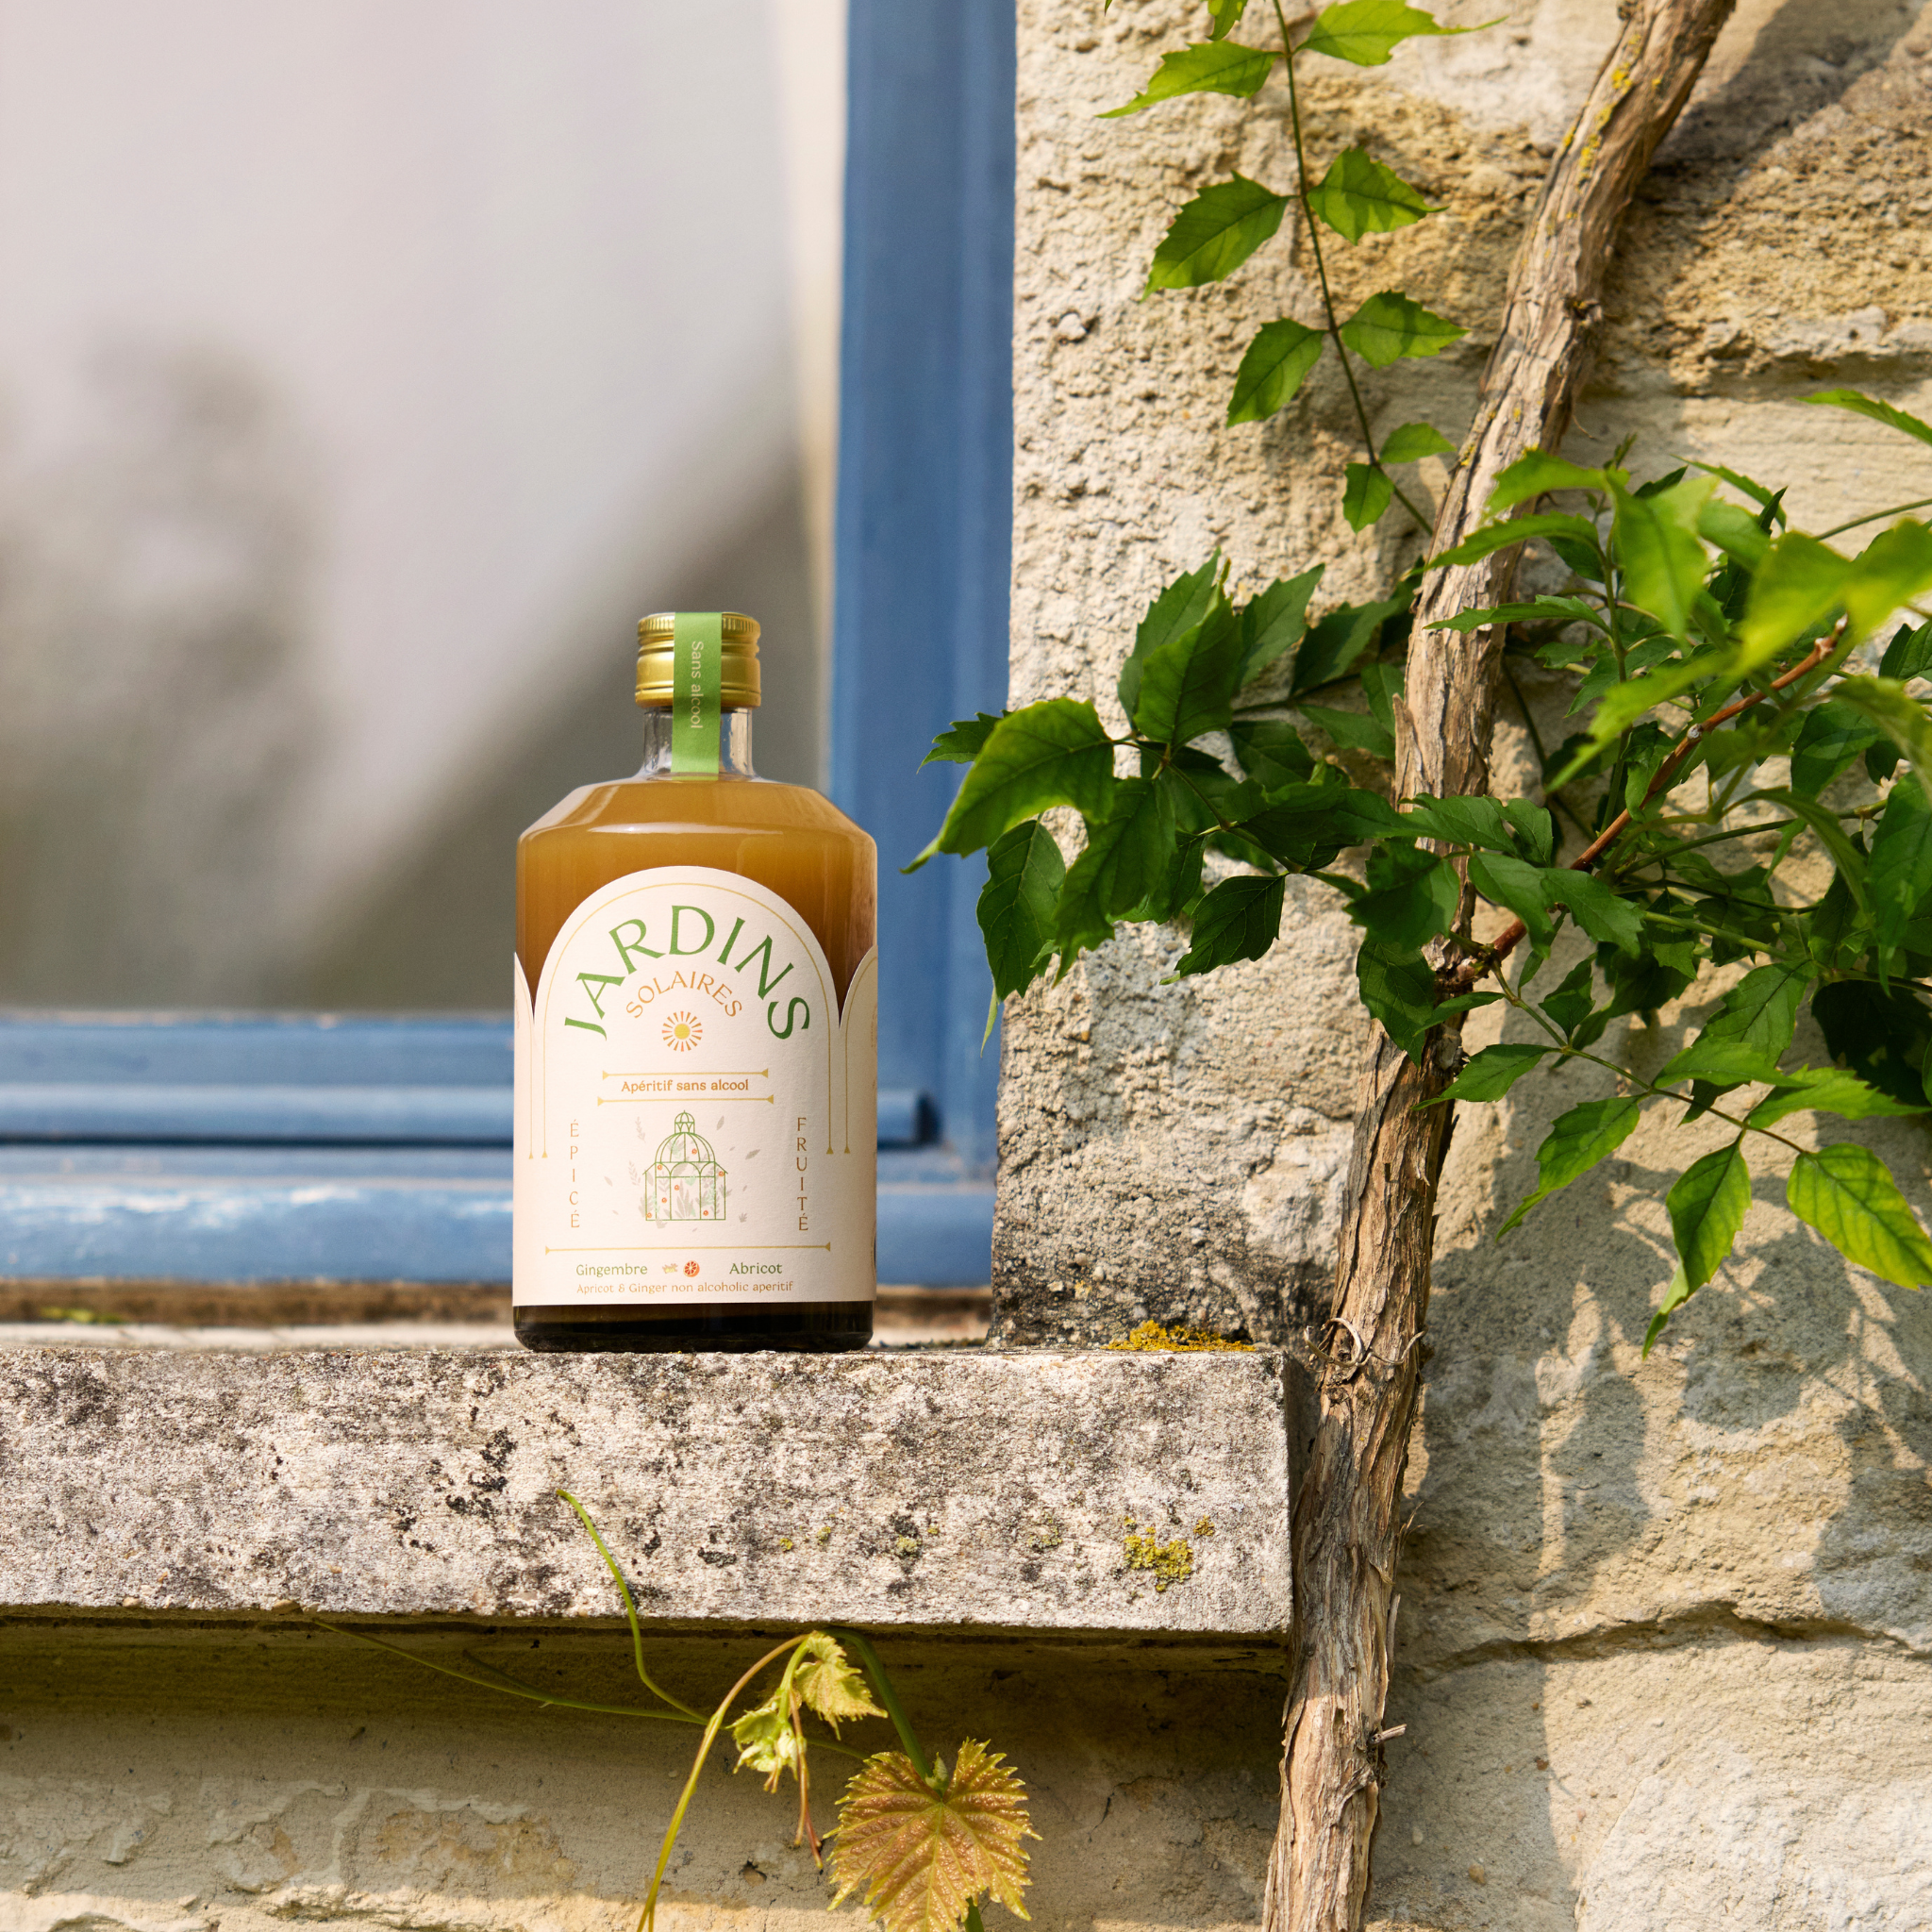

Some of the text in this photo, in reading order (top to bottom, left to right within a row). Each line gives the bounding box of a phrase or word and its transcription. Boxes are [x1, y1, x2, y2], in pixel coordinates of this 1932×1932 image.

[690, 641, 705, 728] Sans alcool
[564, 905, 810, 1041] JARDINS
[625, 971, 743, 1019] SOLAIRES
[622, 1079, 749, 1092] Apéritif sans alcool
[569, 1119, 580, 1228] ÉPICÉ
[796, 1117, 809, 1232] FRUITÉ
[575, 1262, 783, 1277] Gingembre Abricot
[576, 1280, 793, 1295] Apricot & Ginger non alcoholic aperitif
